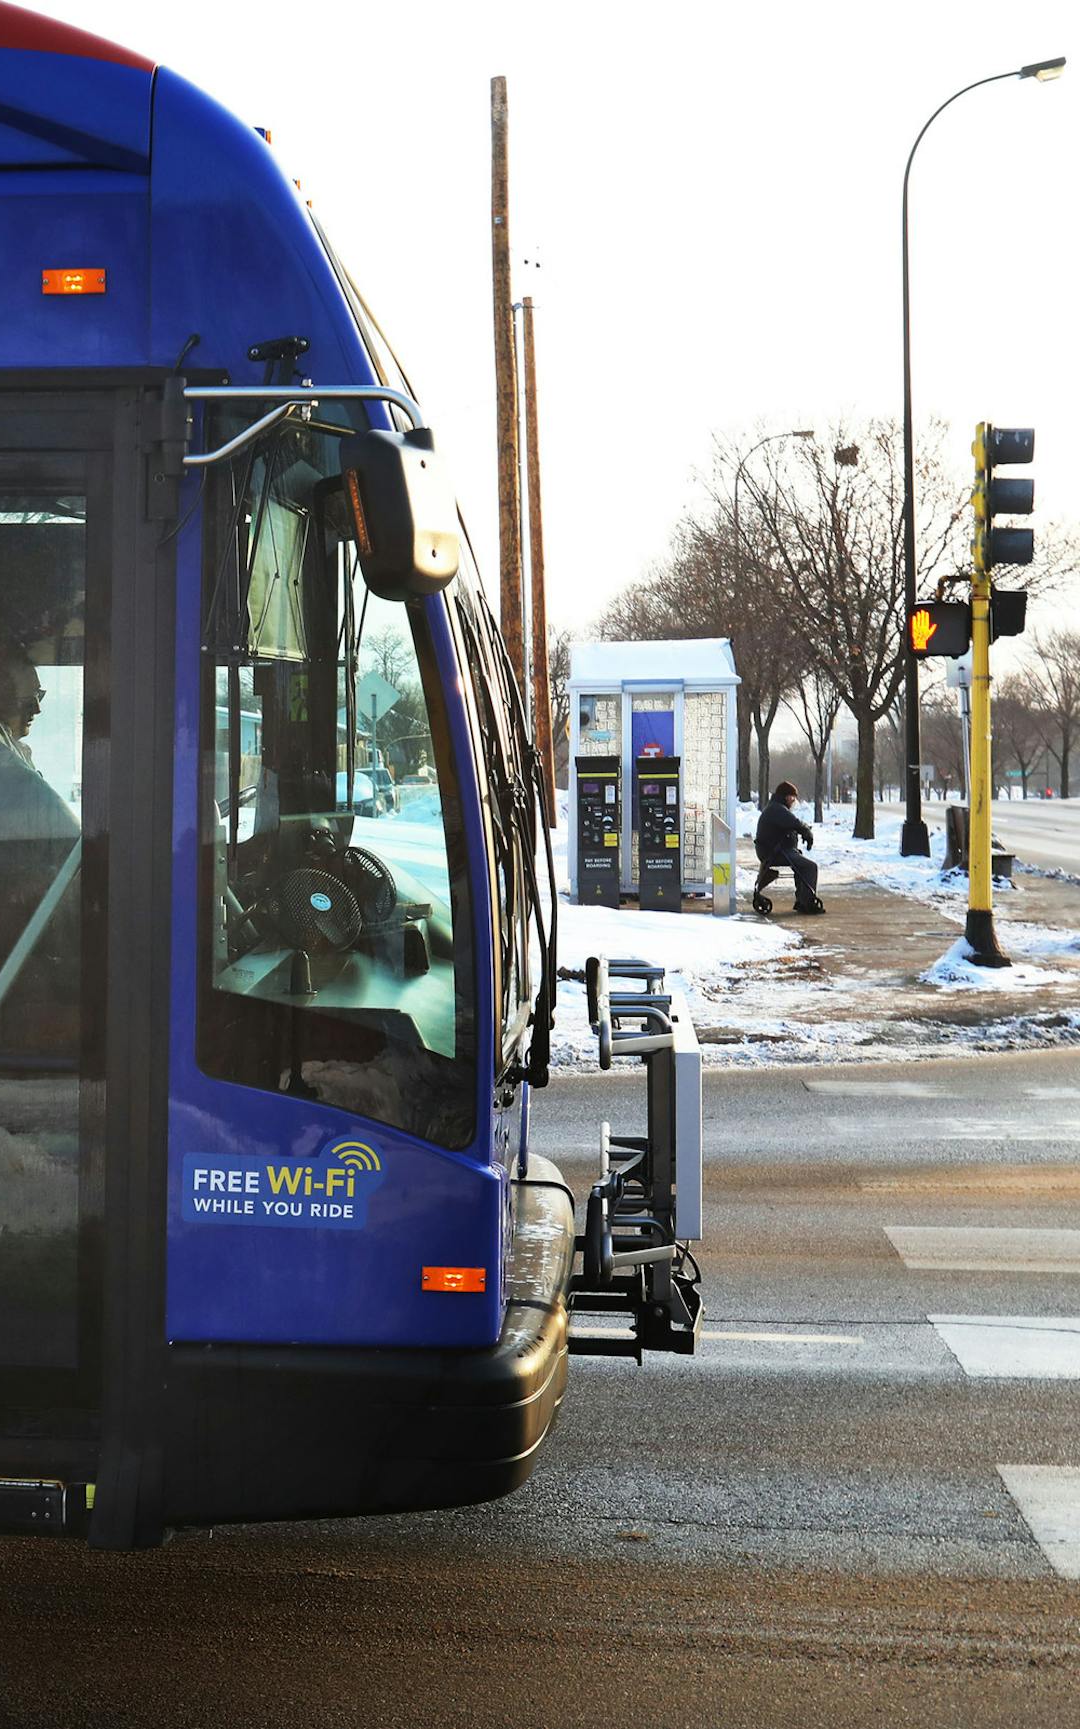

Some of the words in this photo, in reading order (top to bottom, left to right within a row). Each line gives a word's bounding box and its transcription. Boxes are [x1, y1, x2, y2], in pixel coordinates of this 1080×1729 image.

[193, 1168, 260, 1194] FREE
[266, 1165, 356, 1198] Wi-Fi
[193, 1197, 255, 1215] WHILE
[262, 1201, 303, 1217] YOU
[310, 1203, 354, 1219] RIDE
